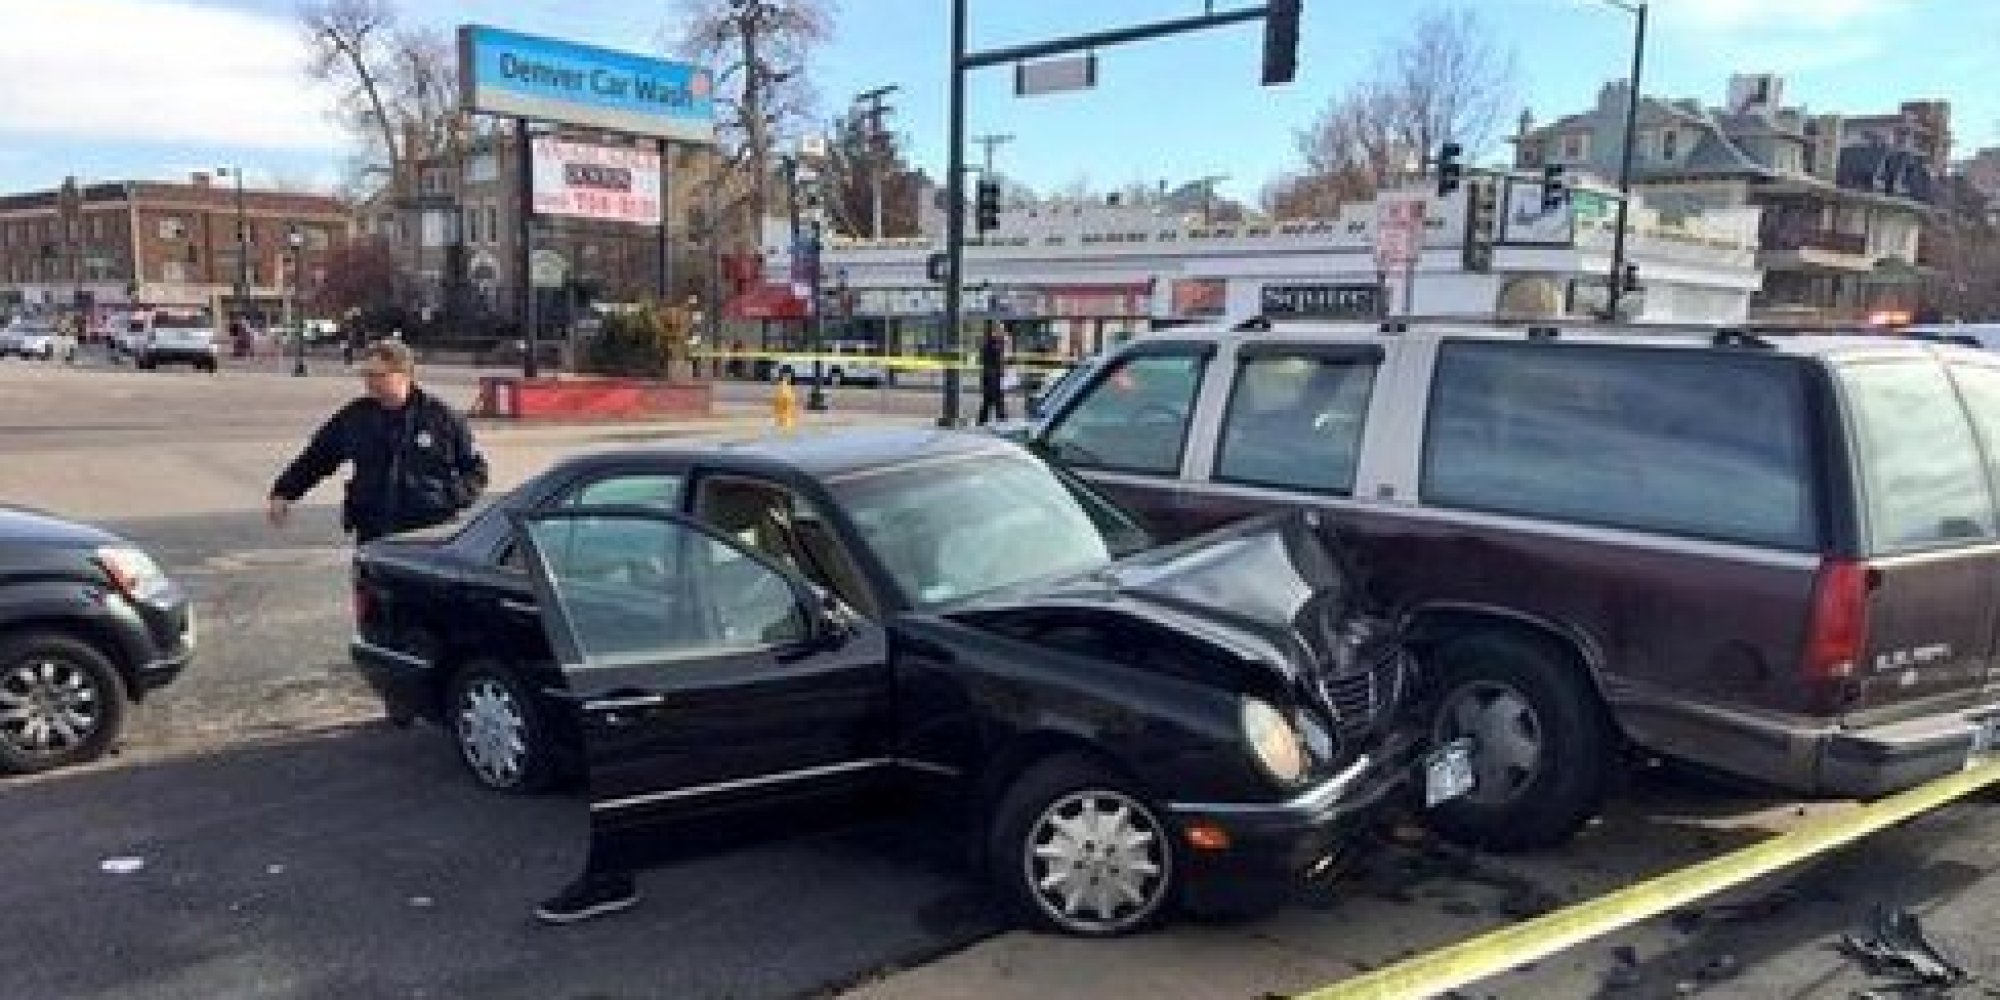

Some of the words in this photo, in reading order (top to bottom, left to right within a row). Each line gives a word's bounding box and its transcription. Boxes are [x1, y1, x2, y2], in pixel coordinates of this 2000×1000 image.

[500, 52, 584, 91] Denver
[590, 69, 629, 96] Car
[635, 76, 694, 108] Wash
